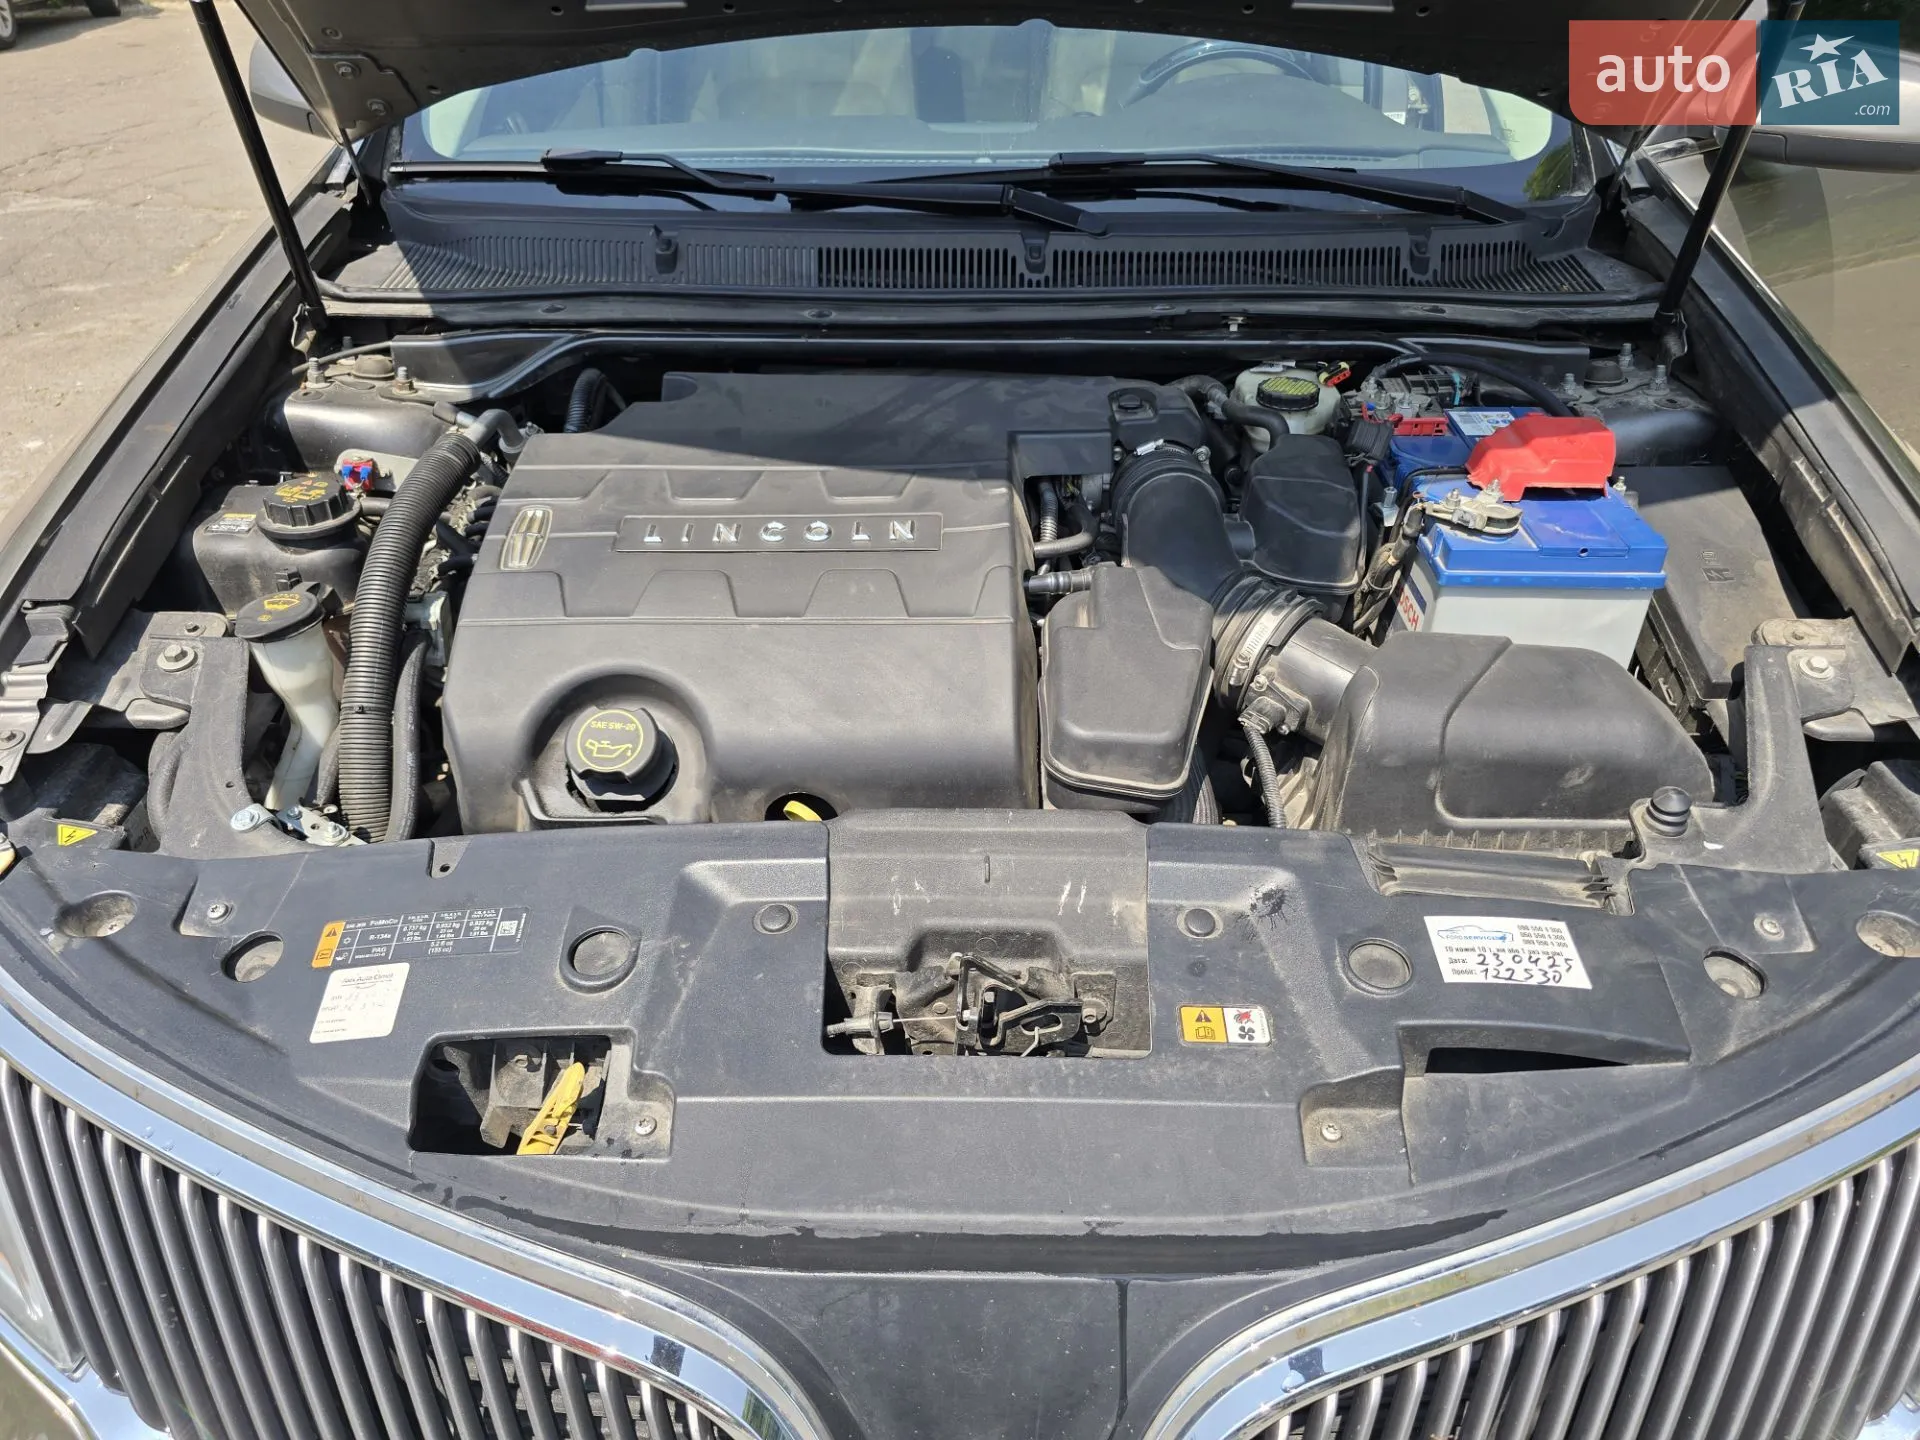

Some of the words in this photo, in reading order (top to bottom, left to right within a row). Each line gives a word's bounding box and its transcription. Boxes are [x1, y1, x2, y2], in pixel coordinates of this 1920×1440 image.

[643, 519, 918, 543] LINCOLN
[590, 720, 607, 729] SAE
[1481, 967, 1562, 984] 122530
